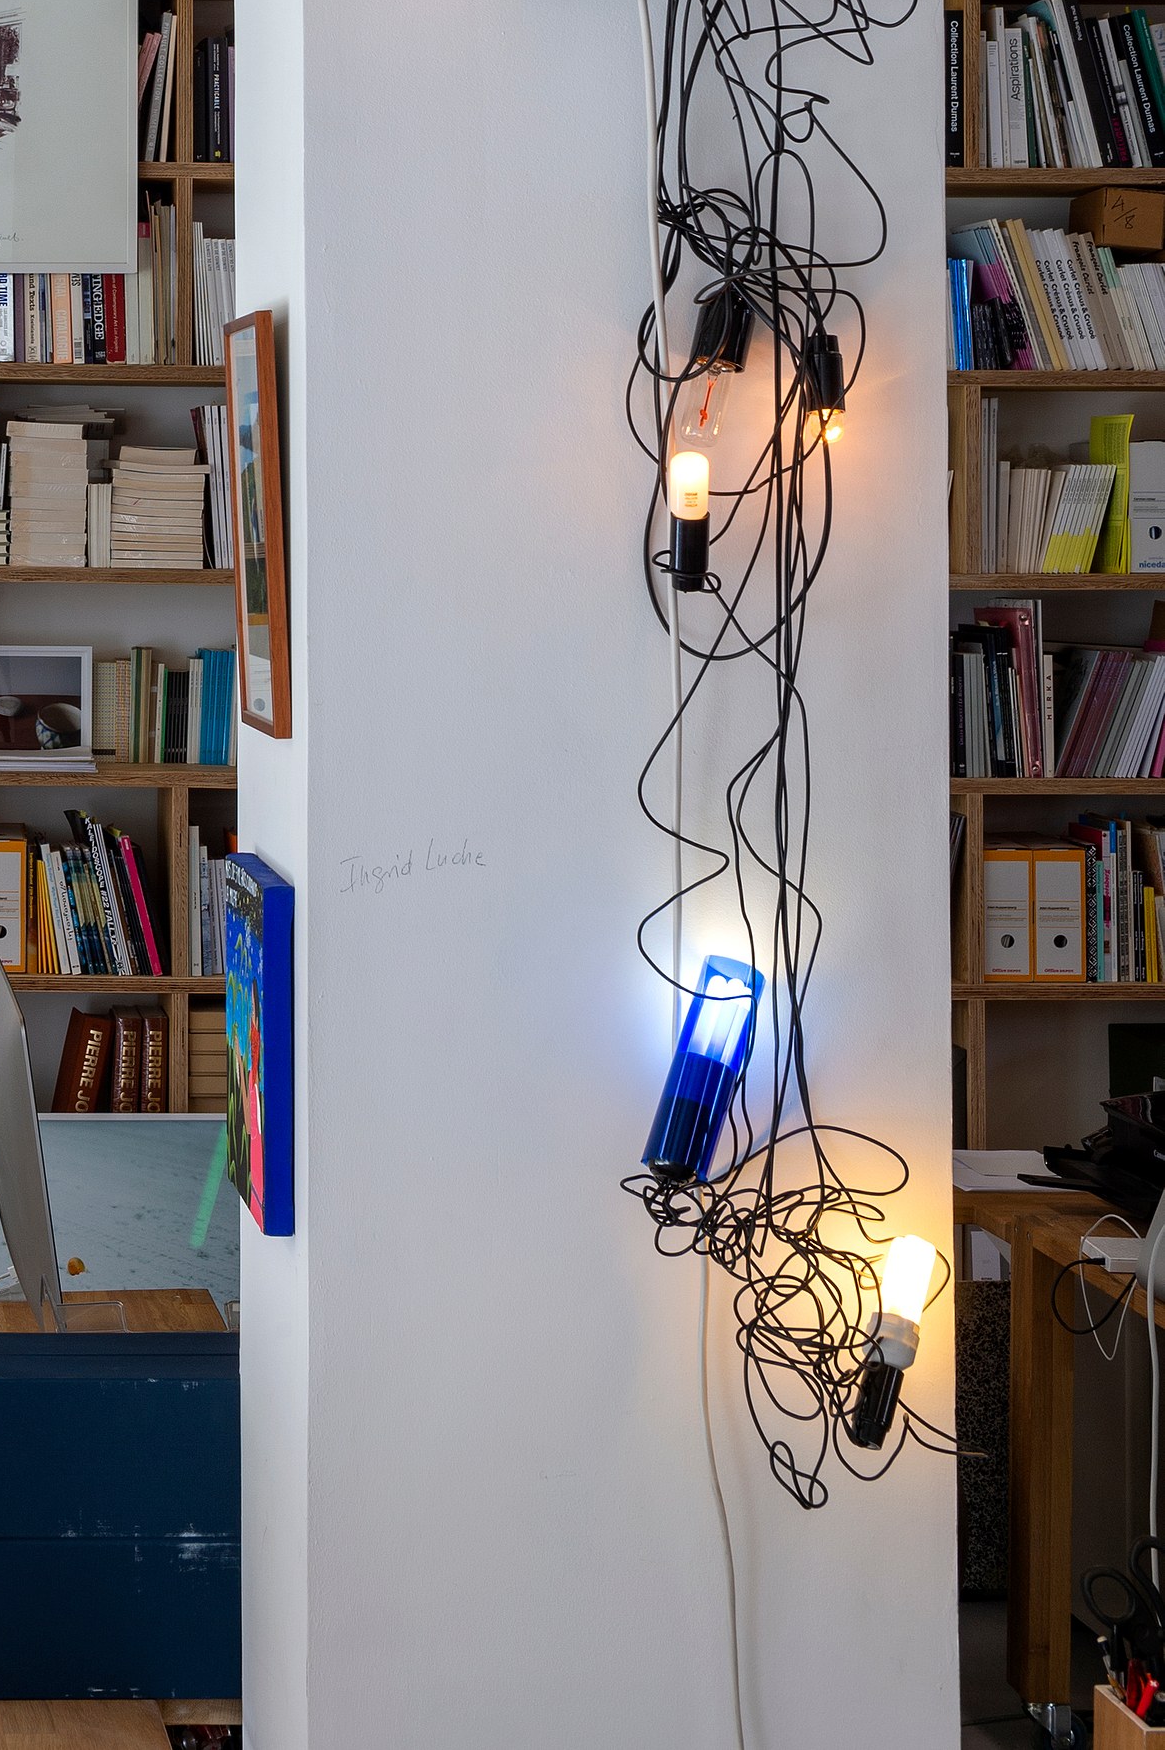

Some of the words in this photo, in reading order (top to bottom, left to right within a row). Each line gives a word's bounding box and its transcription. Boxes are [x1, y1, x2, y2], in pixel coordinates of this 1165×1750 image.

[950, 20, 959, 65] Collection
[213, 73, 221, 110] PRACTICABLE
[950, 66, 959, 100] Laurent
[1010, 38, 1020, 101] Aspirations
[1123, 24, 1138, 67] Collection
[1134, 67, 1147, 102] Laurent
[1143, 102, 1156, 133] Dumas
[950, 101, 959, 132] Dumas
[56, 310, 68, 360] CATALOGUE
[85, 817, 105, 889] KALEIDOSCOPE
[340, 850, 413, 894] Ingrid
[425, 838, 486, 870] Luche
[101, 890, 112, 910] #22
[104, 910, 116, 937] FALL
[79, 1029, 103, 1089] PIERRE
[121, 1030, 137, 1089] PIERRE
[147, 1030, 162, 1089] PIERRE
